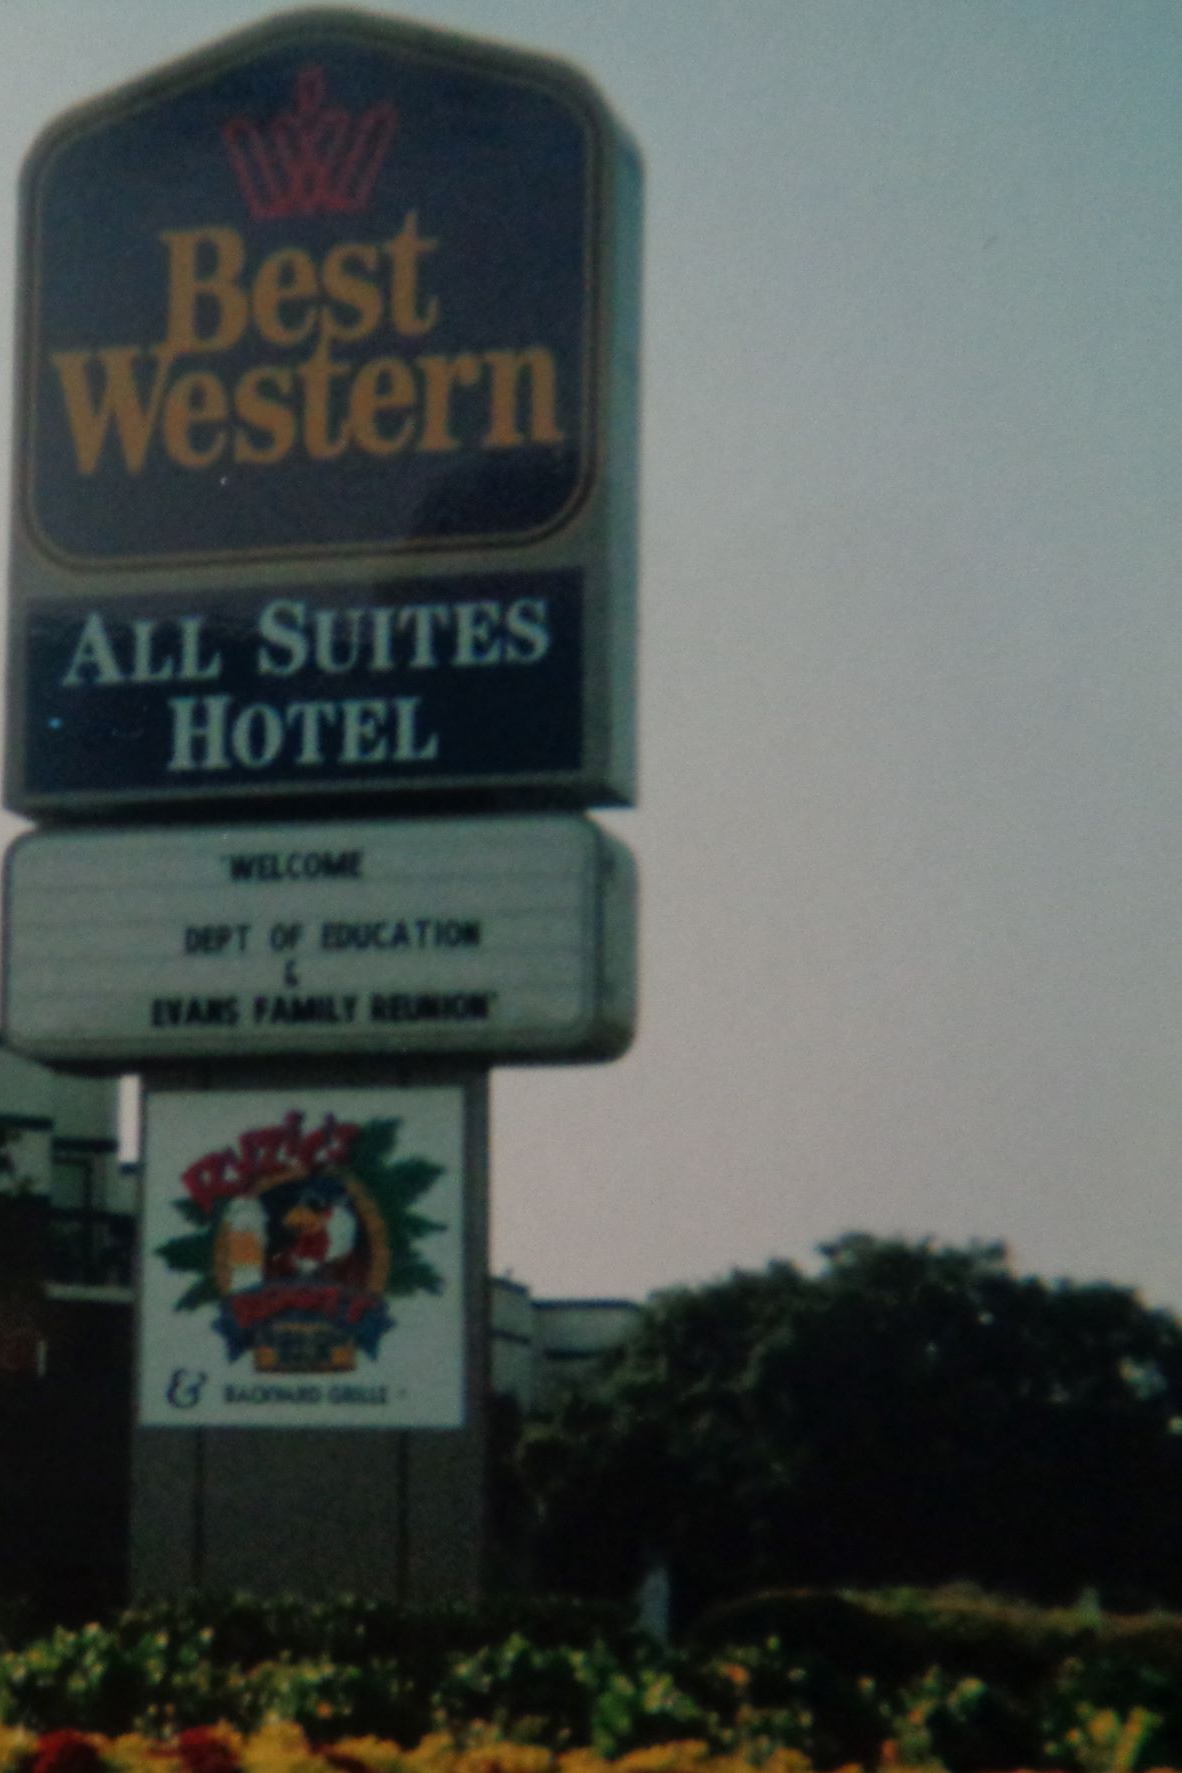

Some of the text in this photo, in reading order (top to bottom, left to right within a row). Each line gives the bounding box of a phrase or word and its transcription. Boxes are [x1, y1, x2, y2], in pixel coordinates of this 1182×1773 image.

[160, 210, 439, 352] Best
[53, 337, 564, 477] Western
[62, 598, 549, 686] ALL SUITES
[167, 695, 439, 772] HOTEL
[184, 917, 482, 954] DEPT OF EDUCATION
[152, 996, 239, 1028] EVANS
[255, 994, 357, 1024] FAMILY
